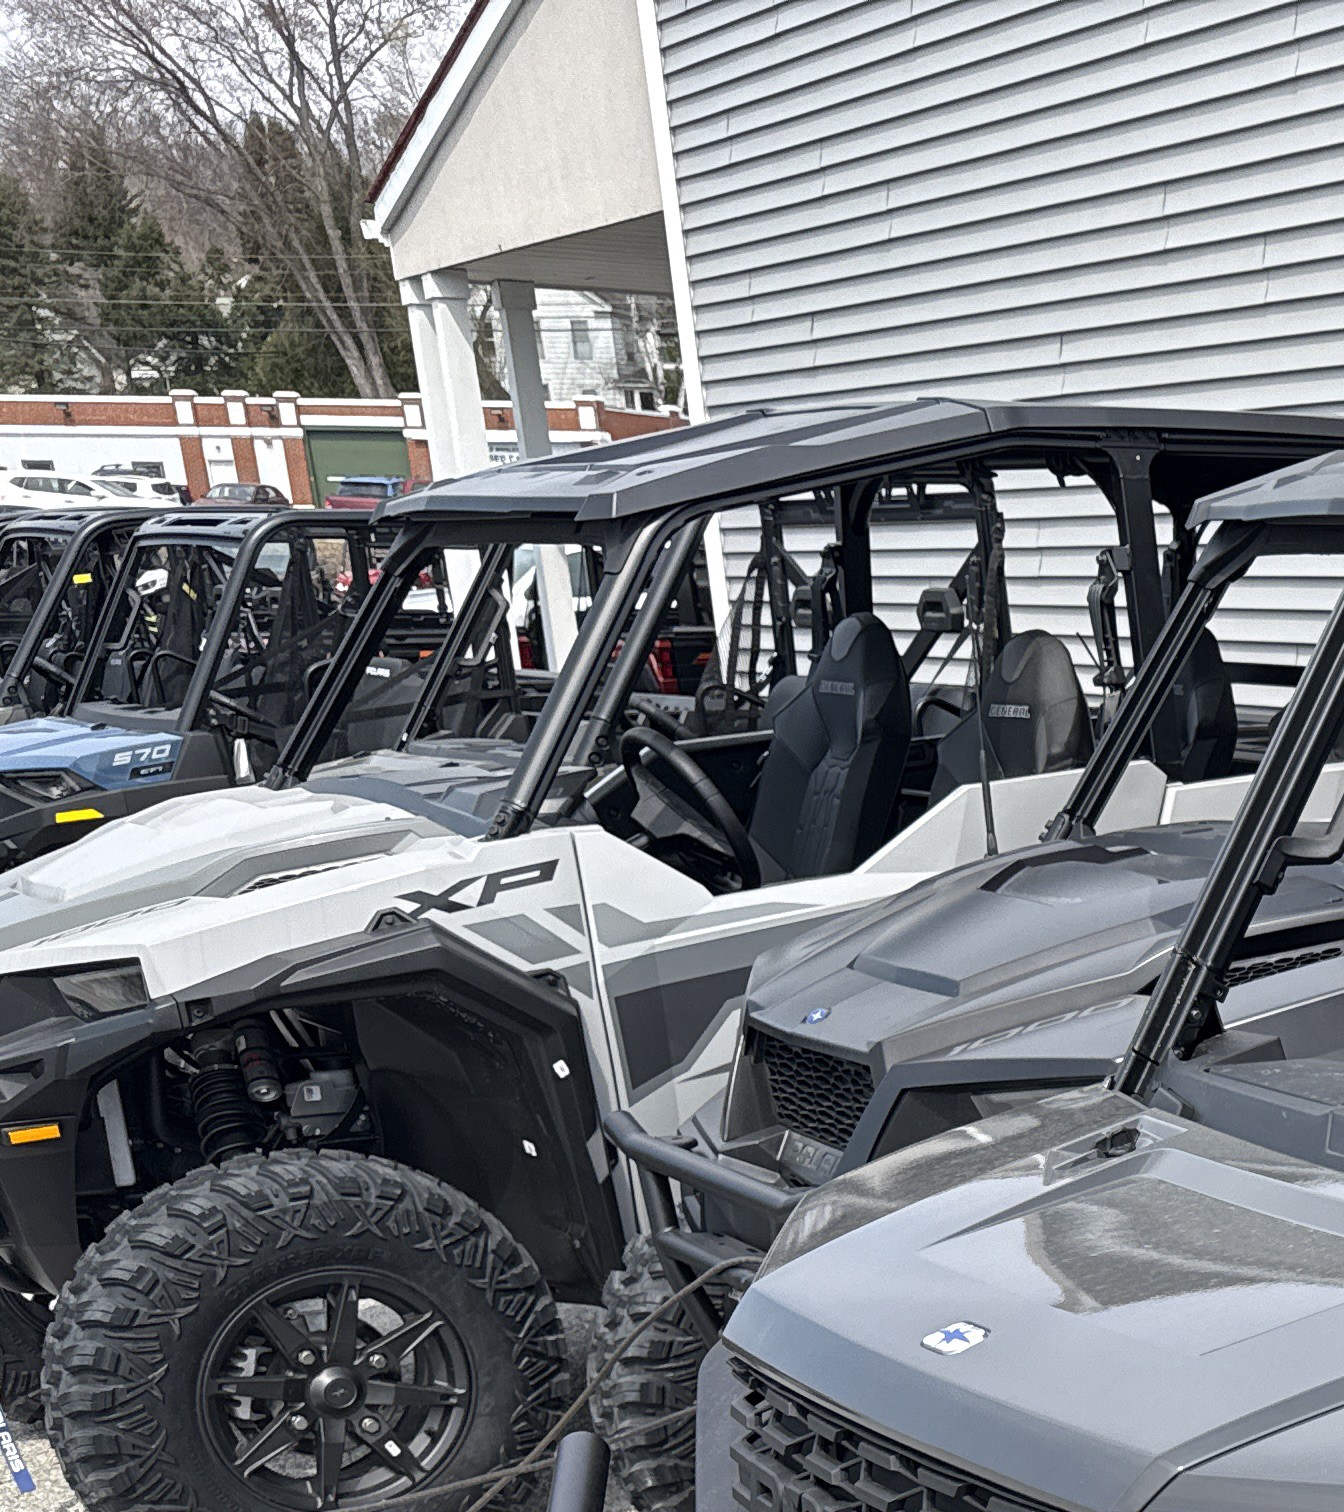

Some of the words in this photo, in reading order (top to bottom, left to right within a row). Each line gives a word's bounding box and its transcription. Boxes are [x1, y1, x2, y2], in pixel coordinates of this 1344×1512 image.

[989, 704, 1031, 719] GENERAL
[112, 744, 172, 767] 570
[393, 858, 561, 920] XP
[0, 1411, 26, 1473] ARIS
